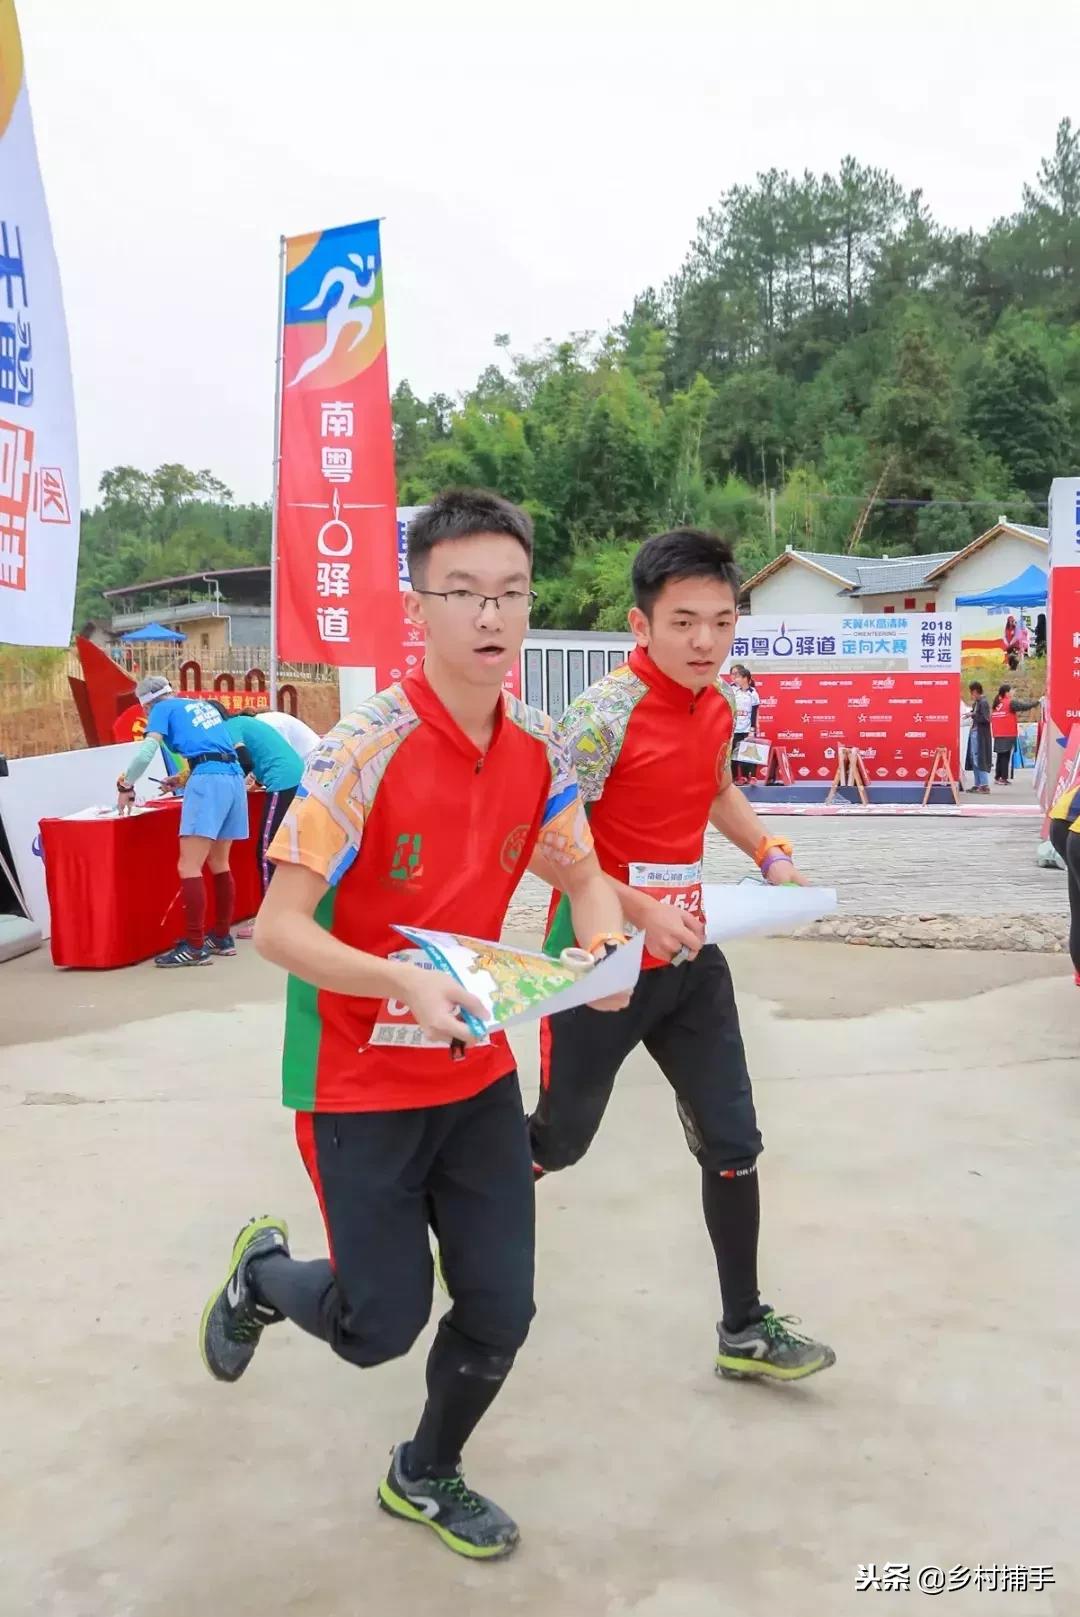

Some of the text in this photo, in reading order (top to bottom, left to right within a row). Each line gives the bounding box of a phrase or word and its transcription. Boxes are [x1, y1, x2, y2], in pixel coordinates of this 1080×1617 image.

[44, 471, 64, 514] 4K
[921, 621, 953, 631] 2018
[842, 638, 908, 655] 定向大赛
[921, 632, 952, 647] 梅州
[921, 649, 952, 663] 平远
